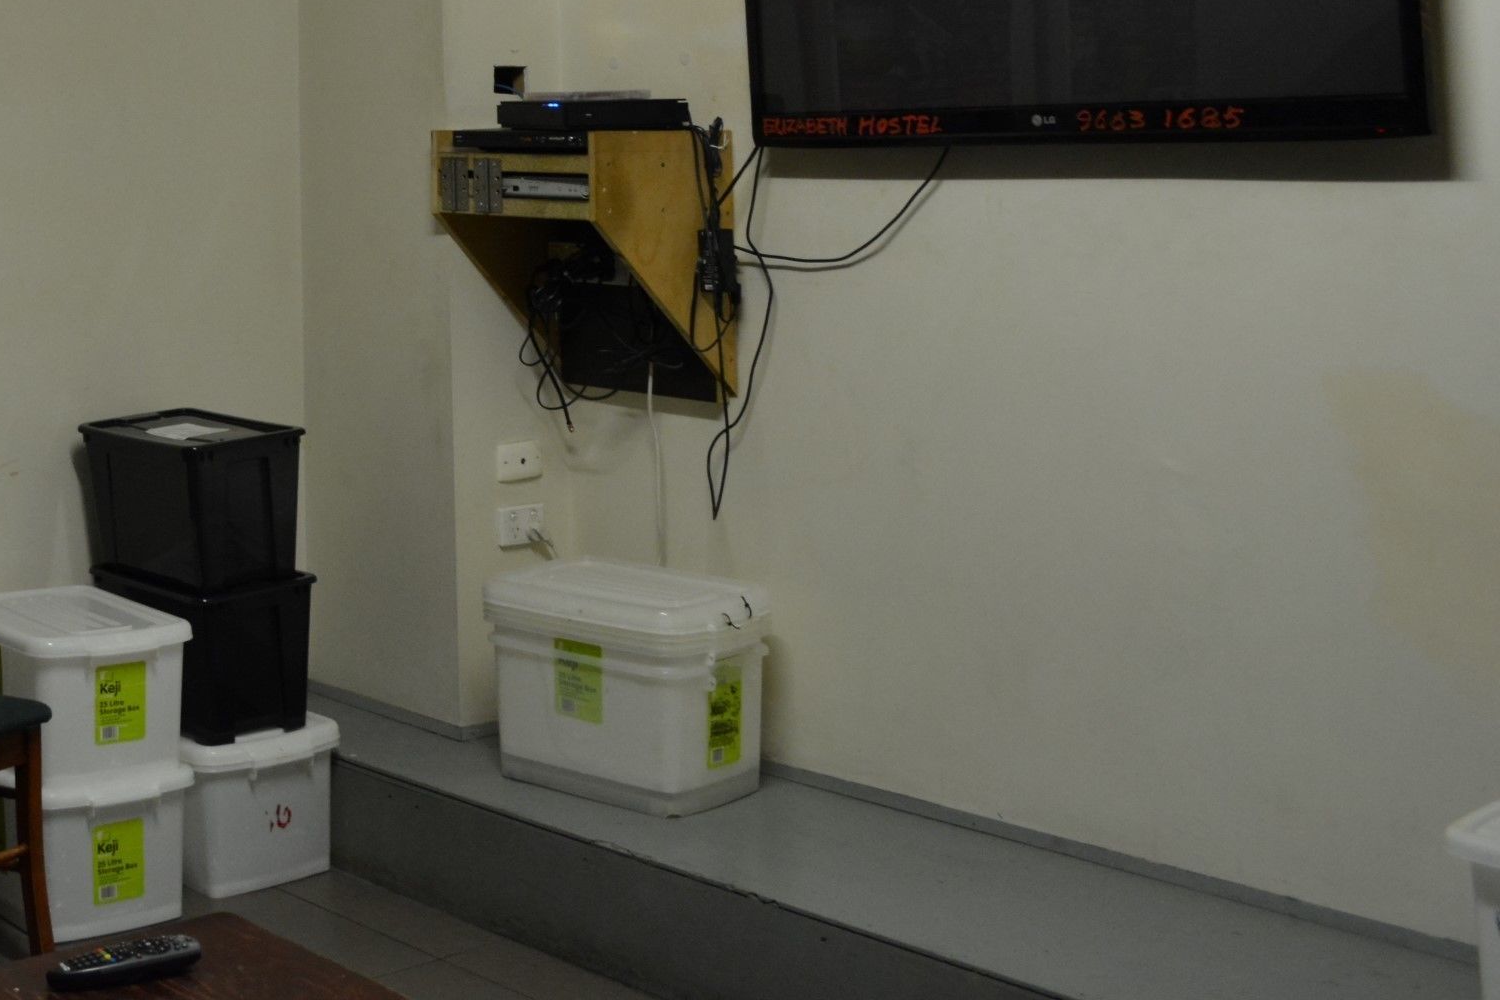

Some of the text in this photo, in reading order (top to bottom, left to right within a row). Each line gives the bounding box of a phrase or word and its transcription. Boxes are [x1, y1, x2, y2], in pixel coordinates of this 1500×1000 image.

[763, 112, 943, 137] ELIZABETH HOSTEL
[1076, 105, 1245, 132] 9663 1685
[100, 680, 121, 697] Keji
[100, 706, 126, 715] Storage
[98, 840, 119, 856] Keji
[98, 866, 125, 875] Storage
